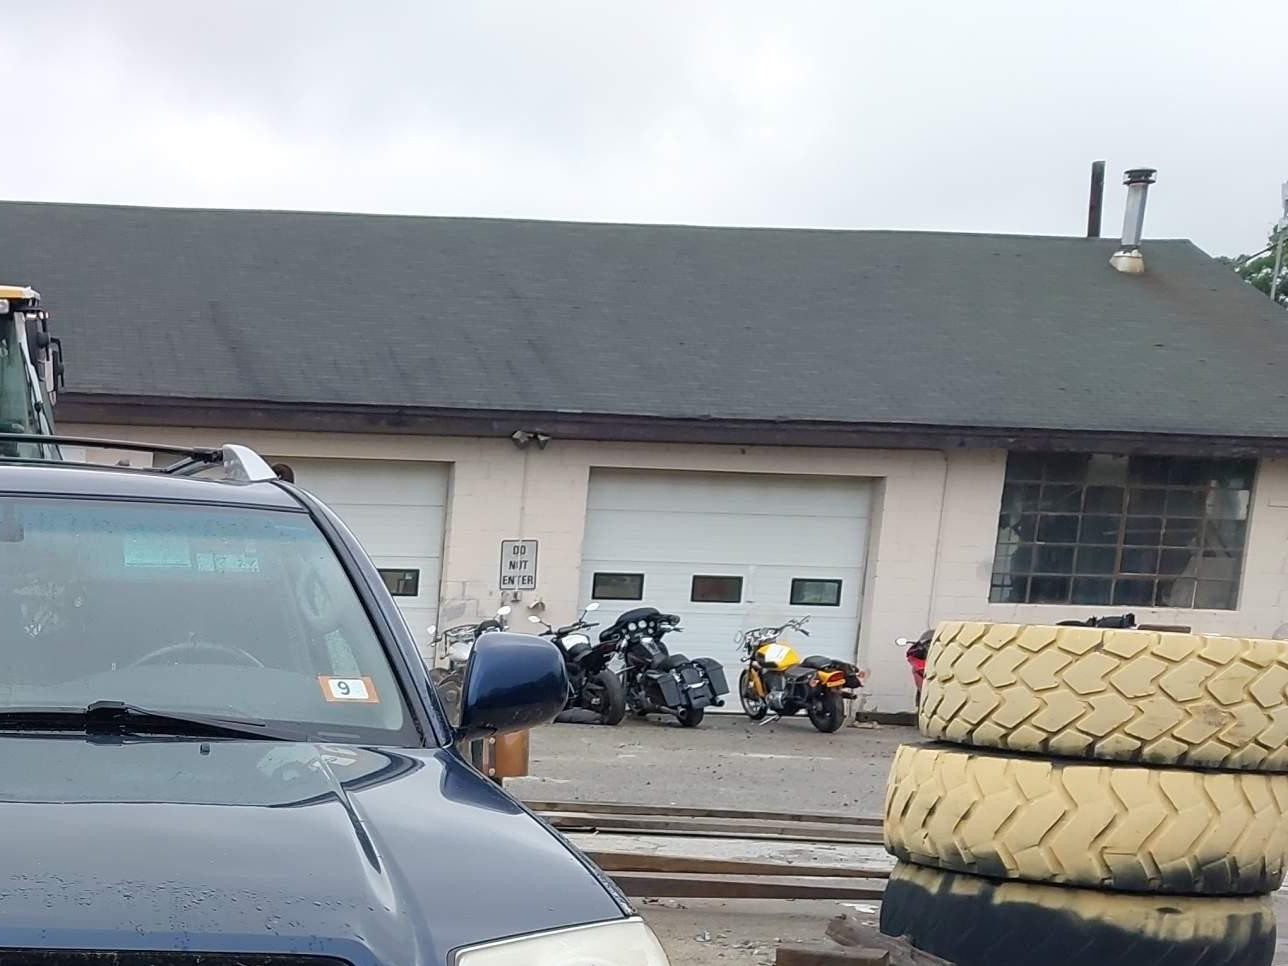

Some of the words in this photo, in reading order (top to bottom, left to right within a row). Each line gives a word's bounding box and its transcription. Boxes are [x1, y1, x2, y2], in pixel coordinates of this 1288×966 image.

[512, 544, 527, 555] DO
[502, 575, 534, 585] ENTER
[337, 680, 351, 696] 9
